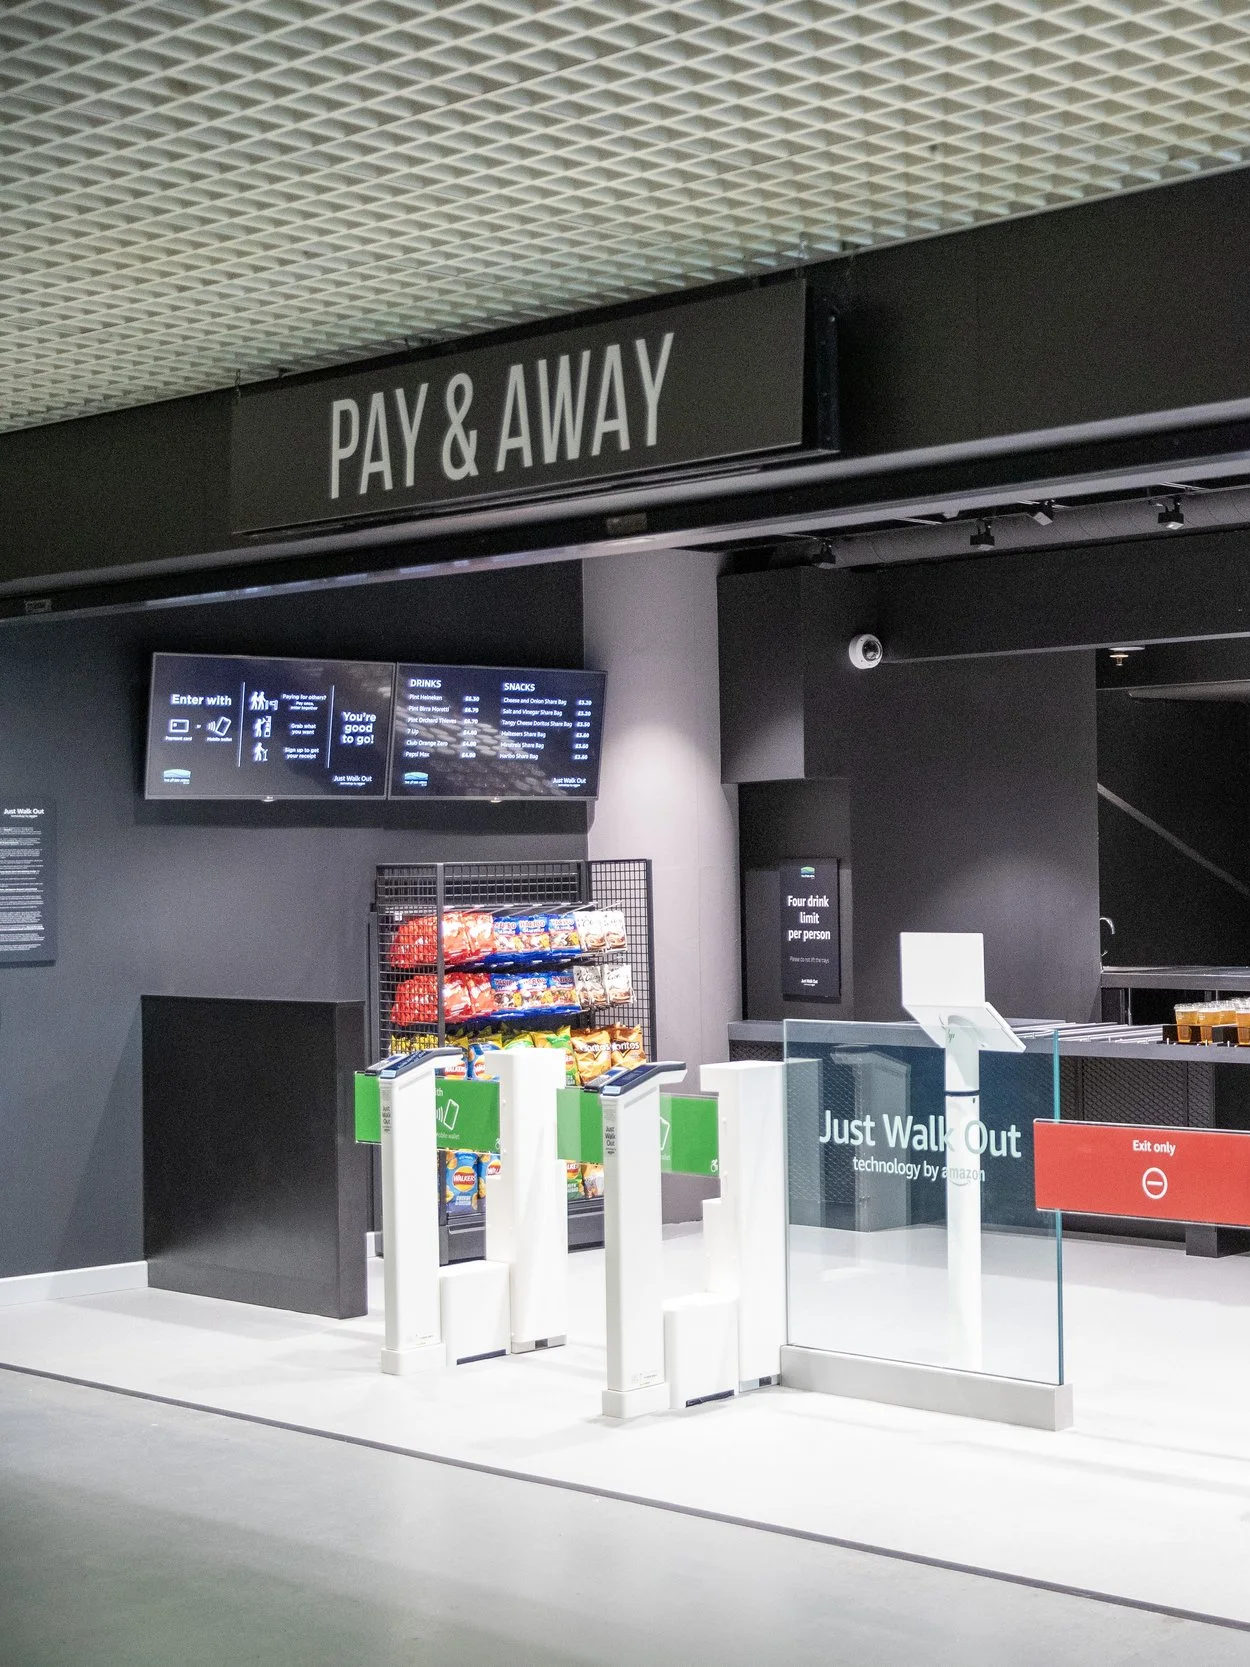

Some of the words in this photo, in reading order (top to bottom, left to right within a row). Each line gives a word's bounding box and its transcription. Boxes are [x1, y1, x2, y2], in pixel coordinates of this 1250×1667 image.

[331, 382, 429, 499] PAY
[442, 372, 478, 481] &
[496, 332, 674, 472] AWAY
[410, 679, 442, 688] DRINKS
[504, 683, 535, 692] SNACKS
[172, 694, 204, 705] Enter
[207, 695, 232, 706] with
[343, 711, 377, 722] You're
[345, 723, 373, 734] good
[342, 734, 354, 744] to
[356, 734, 374, 746] go!
[788, 895, 806, 907] Four
[807, 894, 829, 908] drink
[800, 912, 819, 924] limit
[788, 929, 801, 941] per
[803, 930, 831, 942] person
[819, 1110, 876, 1147] Just
[882, 1113, 956, 1152] Walk
[964, 1120, 1022, 1158] Out
[1132, 1139, 1152, 1152] Exit
[1154, 1141, 1176, 1157] only
[852, 1156, 921, 1180] technology
[923, 1160, 940, 1182] by
[941, 1167, 986, 1183] amazon
[453, 1174, 475, 1182] WALKERS
